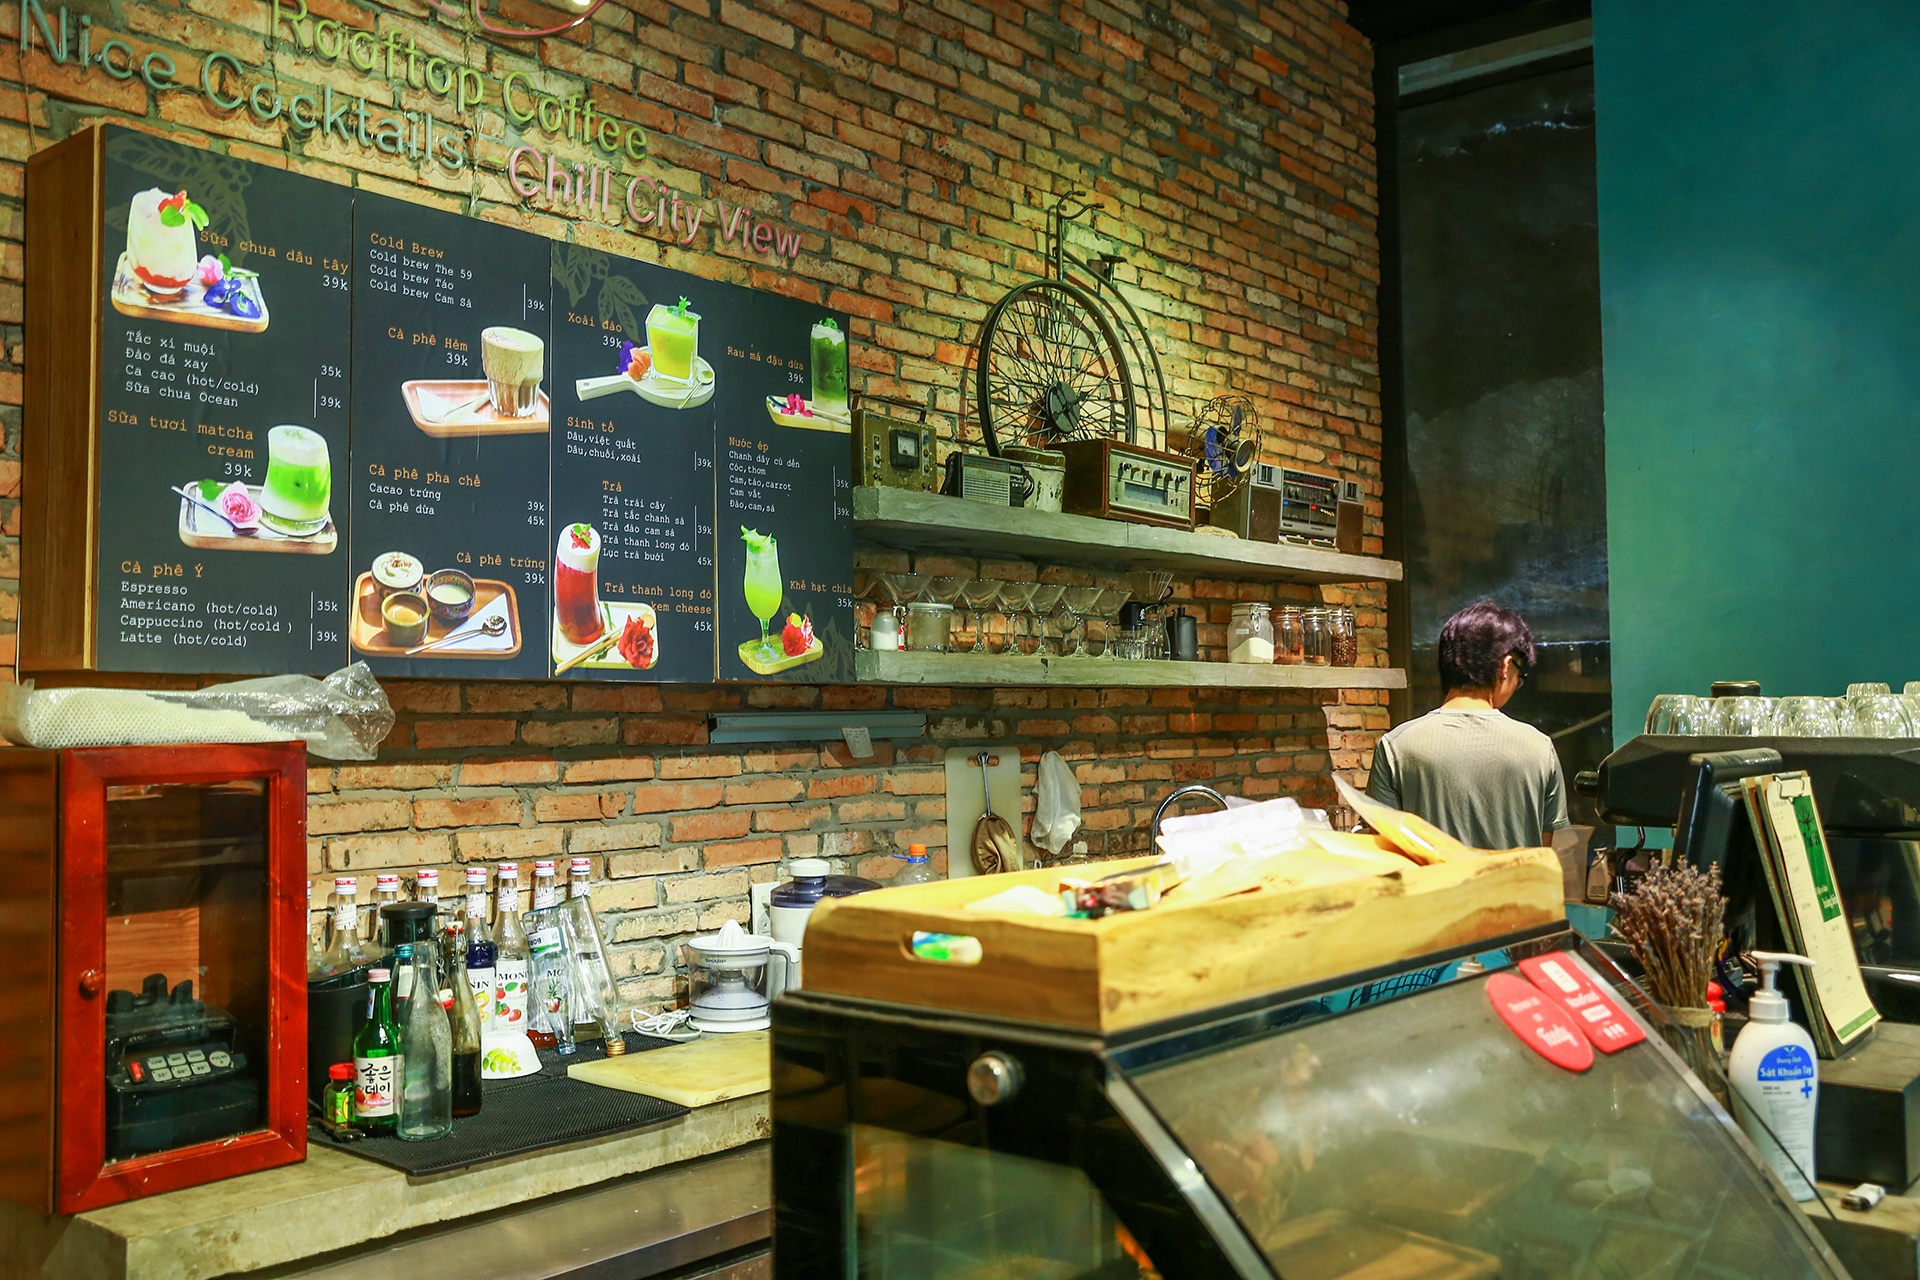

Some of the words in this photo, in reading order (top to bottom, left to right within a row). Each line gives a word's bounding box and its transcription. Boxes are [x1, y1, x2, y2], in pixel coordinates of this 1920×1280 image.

[20, 0, 176, 90] Nice
[201, 51, 466, 171] Cocktails
[272, 0, 482, 112] Rooftop
[503, 70, 647, 160] Coffee
[507, 145, 610, 213] Chill
[626, 176, 703, 245] City
[718, 200, 802, 259] View
[370, 232, 404, 251] Cold
[411, 242, 444, 259] Brew
[239, 240, 276, 257] chua
[286, 249, 313, 266] dâu
[323, 256, 349, 275] tây
[370, 249, 397, 264] Cold
[403, 256, 429, 271] brew
[435, 264, 453, 277] The
[460, 269, 472, 280] 59
[323, 275, 348, 291] 39k
[370, 264, 397, 278] Cold
[403, 270, 429, 285] brew
[435, 278, 454, 291] Táo
[370, 279, 397, 293] Cold
[403, 285, 429, 300] brew
[435, 292, 454, 305] Cam
[527, 299, 544, 311] 39k
[413, 332, 436, 346] phê
[603, 336, 622, 348] 39k
[727, 346, 744, 358] Rau
[126, 347, 151, 362] Đào
[160, 353, 175, 366] đá
[184, 359, 208, 372] xay
[446, 353, 468, 367] 39k
[321, 365, 342, 378] 35k
[788, 372, 803, 384] 39k
[126, 365, 142, 377] Ca
[151, 370, 176, 382] cao
[186, 375, 260, 396] (hot/cold)
[159, 386, 191, 400] chua
[199, 392, 238, 408] Ocean
[320, 396, 341, 409] 39k
[567, 416, 594, 430] Sinh
[198, 423, 254, 441] matcha
[207, 445, 254, 459] cream
[729, 451, 752, 461] Chanh
[697, 458, 711, 468] 39k
[224, 463, 251, 478] 39k
[394, 467, 418, 481] phê
[427, 472, 450, 485] pha
[369, 483, 402, 496] Cacao
[836, 480, 849, 489] 35k
[729, 488, 744, 497] Cam
[389, 501, 409, 513] phê
[527, 501, 544, 512] 39k
[837, 508, 849, 517] 39k
[527, 515, 544, 526] 45k
[645, 515, 669, 524] chanh
[645, 528, 660, 536] cam
[697, 525, 711, 534] 39k
[624, 537, 649, 547] thanh
[655, 541, 675, 551] long
[479, 554, 501, 566] phê
[697, 557, 711, 566] 45k
[153, 561, 183, 579] phê
[524, 573, 545, 584] 39k
[121, 581, 188, 596] Espresso
[632, 584, 662, 596] thanh
[670, 587, 693, 599] long
[832, 584, 851, 594] chia
[120, 598, 195, 613] Americano
[206, 602, 278, 617] (hot/cold)
[317, 601, 338, 612] 35k
[651, 601, 669, 612] kem
[676, 603, 711, 614] cheese
[838, 598, 852, 608] 35k
[120, 615, 203, 631] Cappuccino
[694, 622, 711, 632] 45k
[120, 631, 162, 644] Latte
[173, 634, 247, 648] (hot/cold)
[317, 631, 337, 642] 39k
[360, 1063, 392, 1083] 좋은
[1760, 1067, 1776, 1077] Sát
[1802, 1065, 1812, 1076] Tay
[365, 1082, 390, 1095] 데이
